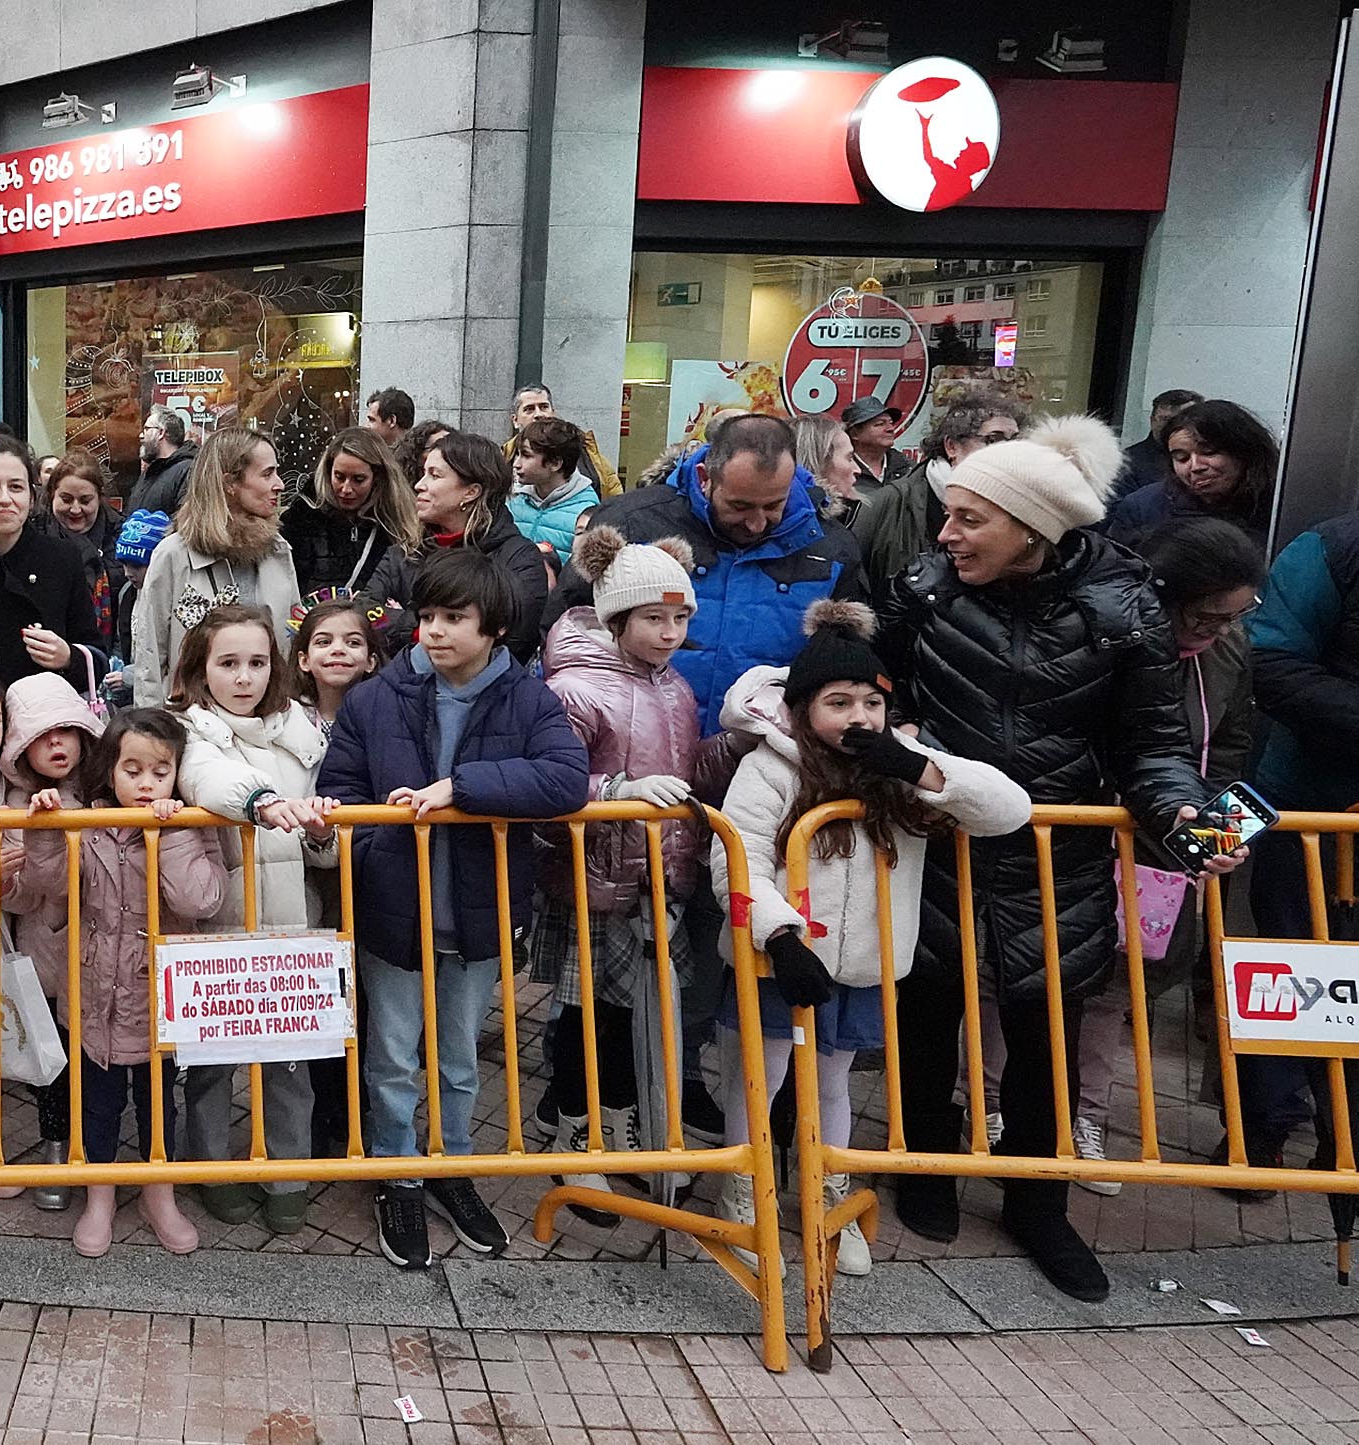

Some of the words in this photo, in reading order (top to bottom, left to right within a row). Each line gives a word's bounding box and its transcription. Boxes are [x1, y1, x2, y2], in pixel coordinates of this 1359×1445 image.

[29, 151, 74, 184] 986
[80, 140, 125, 175] 981
[817, 323, 839, 339] TÚ
[842, 325, 901, 339] ELIGES
[155, 370, 223, 384] TELEPIBOX
[175, 957, 248, 977] PROHIBIDO
[251, 952, 334, 973] ESTACIONAR
[193, 981, 202, 998] A
[205, 978, 241, 1001] partir
[244, 977, 267, 994] das
[270, 975, 304, 992] 08:00
[308, 974, 320, 990] h.
[182, 1002, 197, 1018] do
[201, 997, 254, 1017] SÁBADO
[258, 997, 278, 1014] día
[281, 993, 334, 1013] 07/09/24
[199, 1025, 219, 1042] por
[223, 1020, 262, 1037] FEIRA
[266, 1016, 320, 1034] FRANCA
